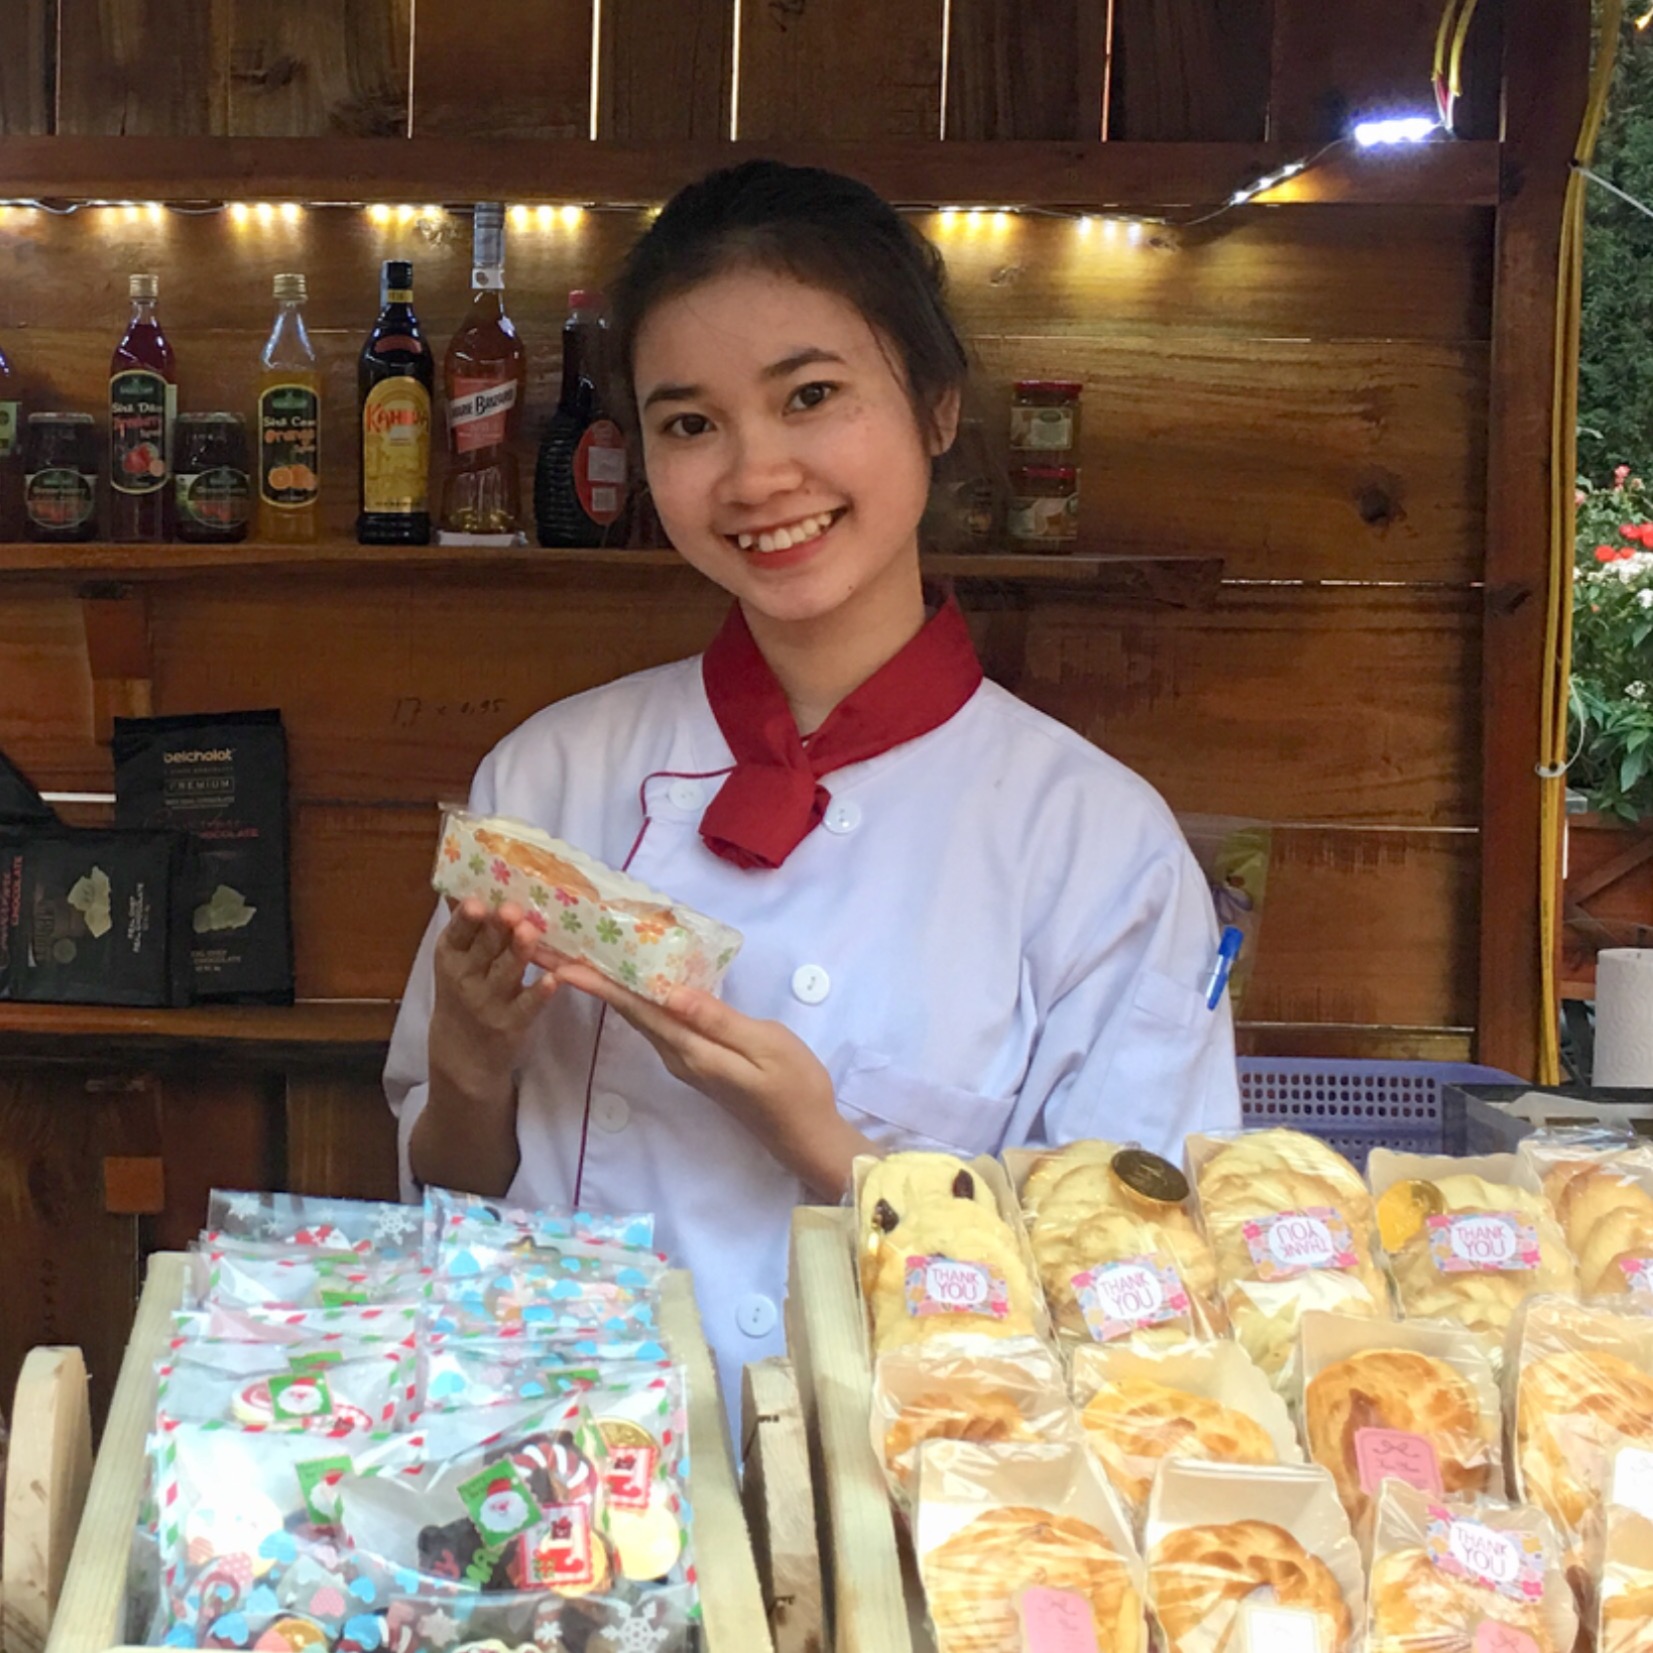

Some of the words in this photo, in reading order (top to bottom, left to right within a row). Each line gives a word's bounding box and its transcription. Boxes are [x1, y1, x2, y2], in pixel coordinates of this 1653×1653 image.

[1275, 1219, 1320, 1245] YOU
[1457, 1225, 1507, 1240] THANK
[1280, 1238, 1330, 1257] THANK
[1462, 1238, 1506, 1259] YOU
[931, 1268, 978, 1284] THANK
[1099, 1270, 1151, 1297] THANK
[937, 1281, 978, 1301] YOU
[1110, 1286, 1155, 1317] YOU
[1456, 1526, 1509, 1556] THANK
[1461, 1542, 1506, 1579] YOU
